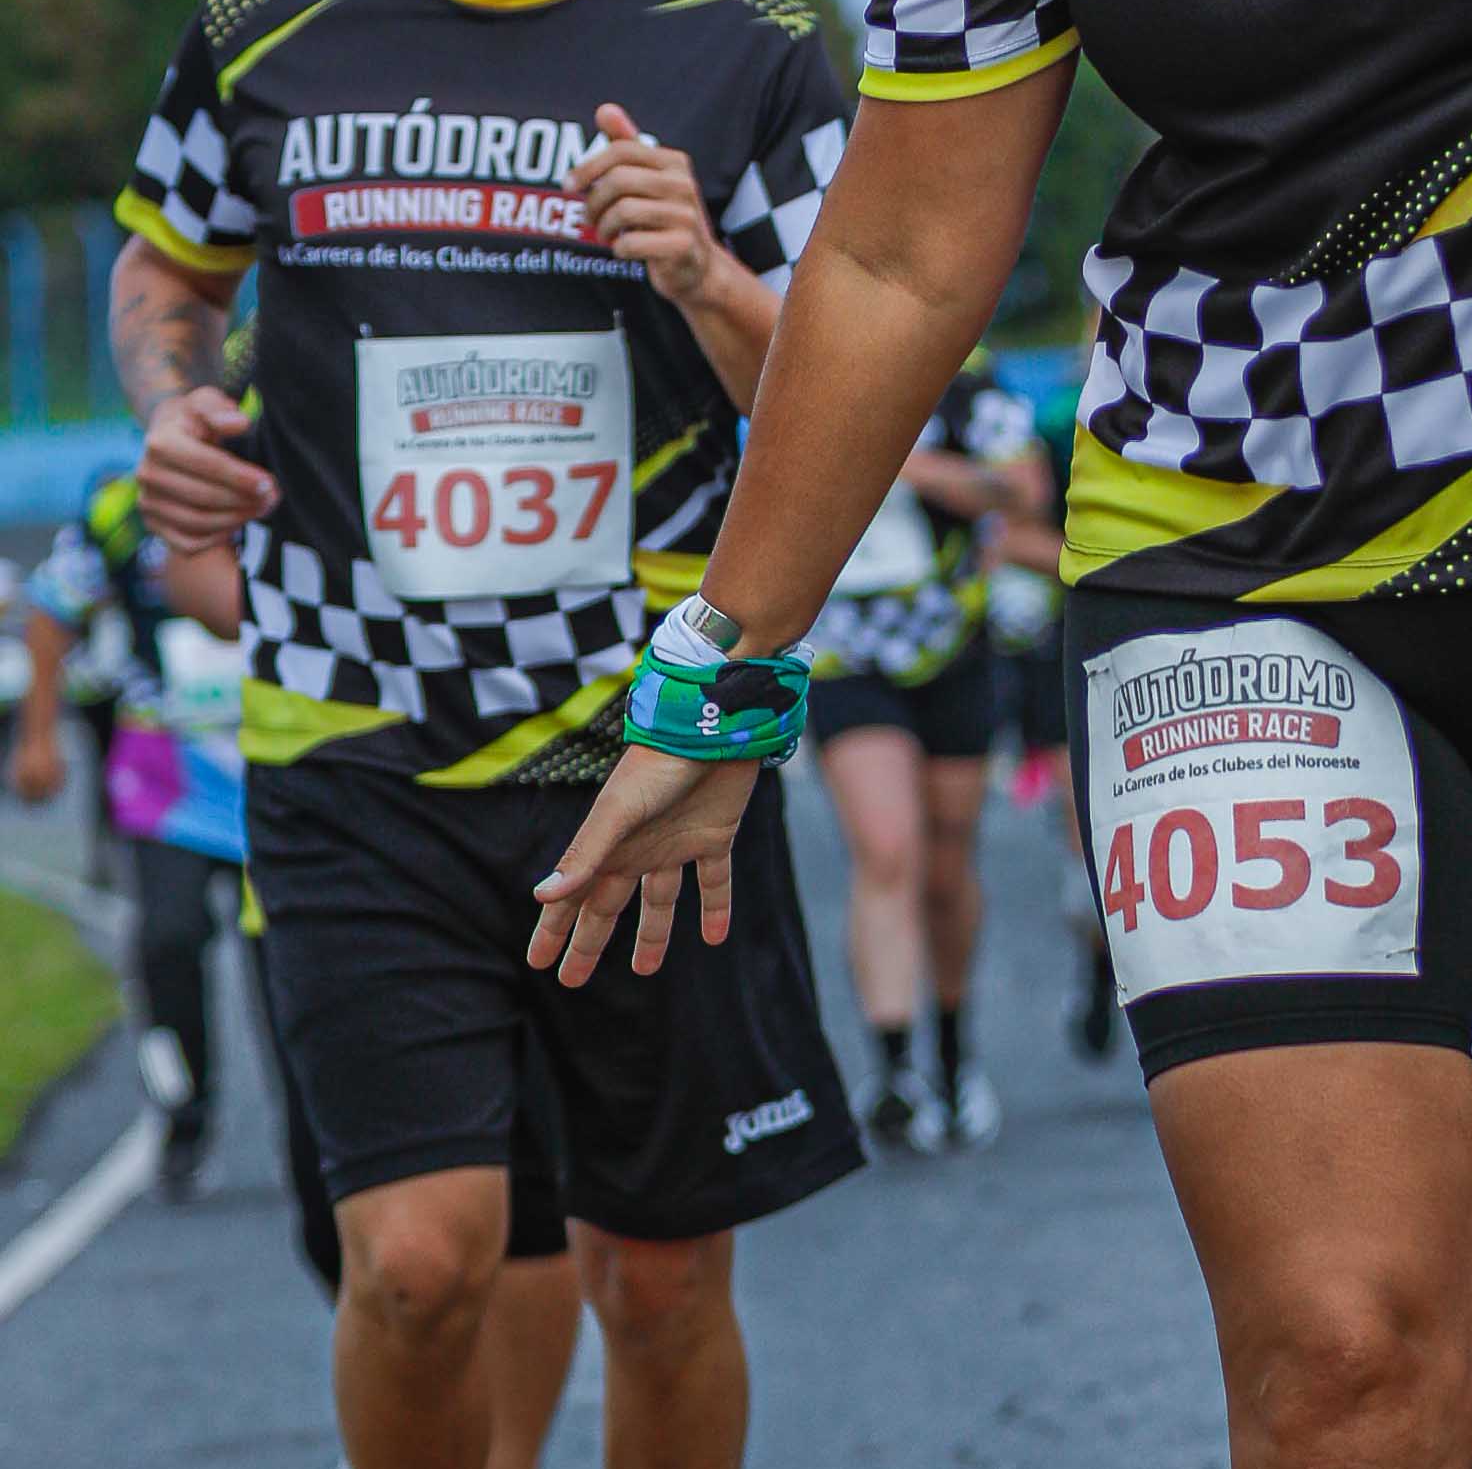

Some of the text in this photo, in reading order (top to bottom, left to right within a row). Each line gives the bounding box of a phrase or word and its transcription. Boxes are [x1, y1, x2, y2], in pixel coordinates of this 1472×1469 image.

[277, 97, 660, 187] AUTÓDROM
[323, 188, 590, 238] RUNNING RACE
[293, 242, 364, 267] Carrera
[367, 243, 397, 269] de
[400, 244, 433, 270] los
[436, 246, 512, 273] Clubes
[514, 248, 548, 274] del
[397, 350, 596, 406] AUTÓDROMO
[373, 461, 619, 550] 4037
[1112, 648, 1356, 738] AUTÓDROMO
[1140, 712, 1314, 762] RUNNING RACE
[1112, 753, 1361, 798] La Carrera de los Clubes del Noroeste
[1104, 797, 1402, 933] 4053
